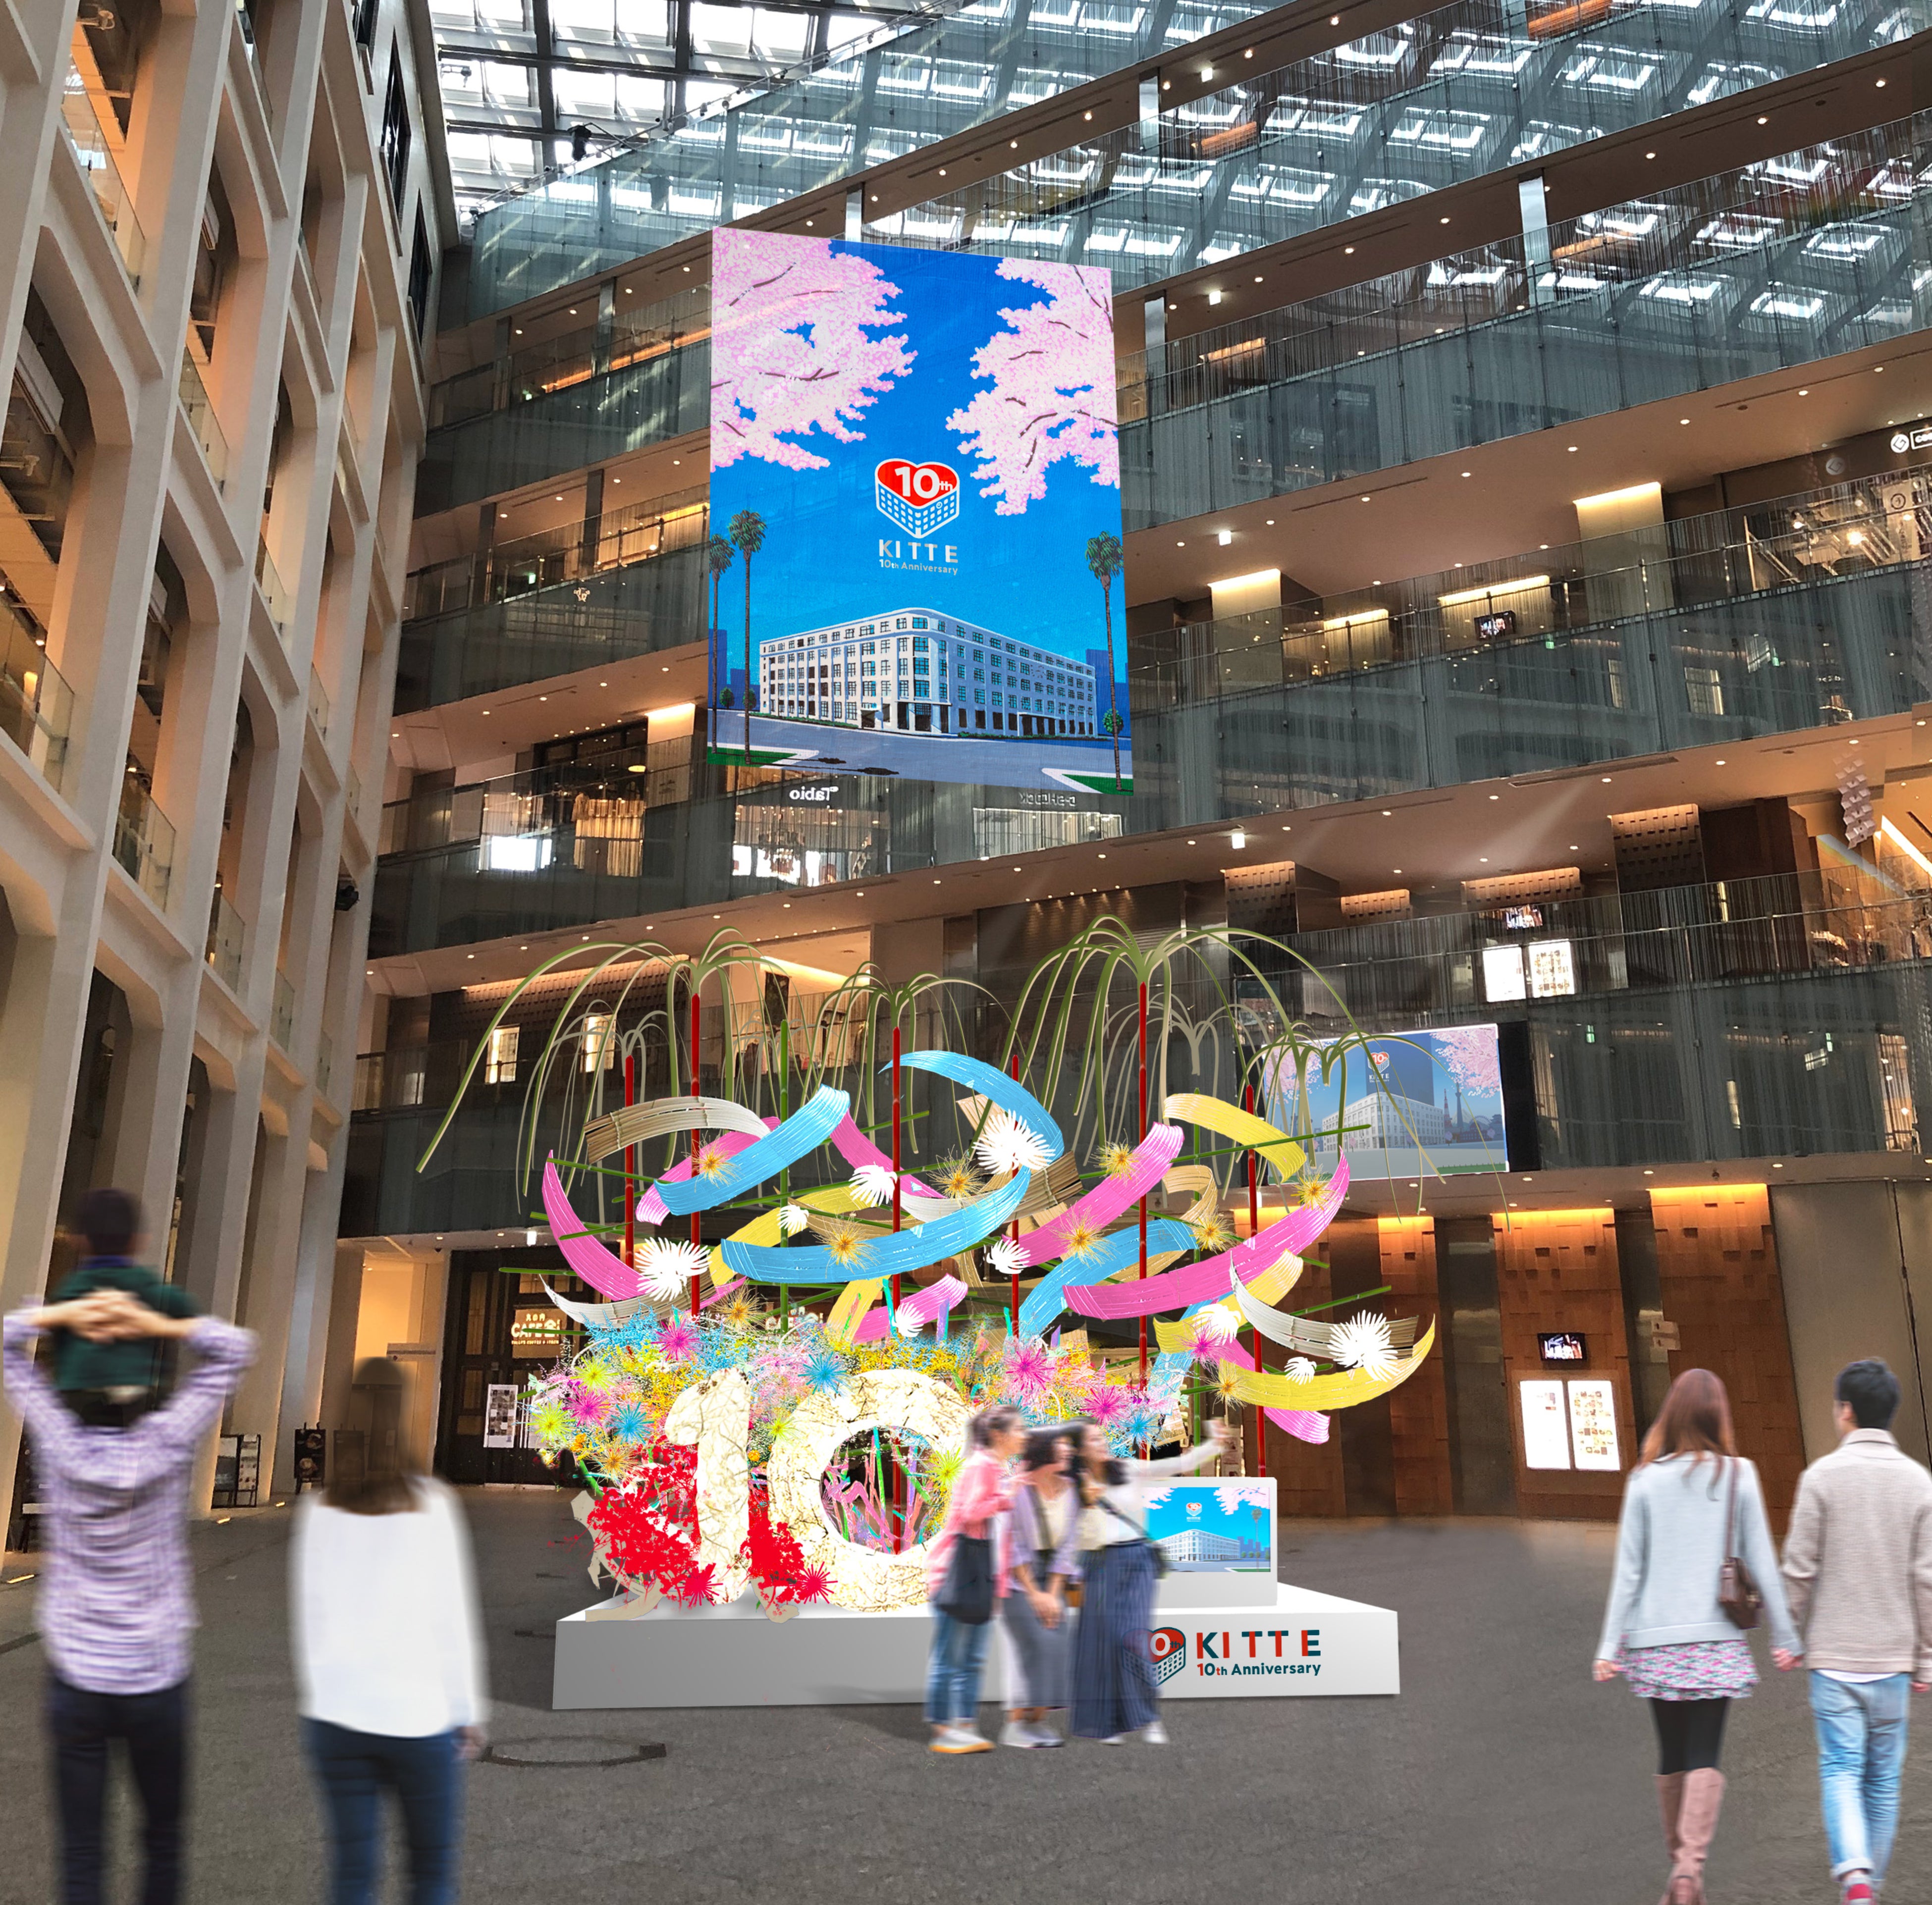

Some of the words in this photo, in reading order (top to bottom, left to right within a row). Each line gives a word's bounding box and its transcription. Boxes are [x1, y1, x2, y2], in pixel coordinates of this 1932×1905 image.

[895, 466, 953, 499] 10th
[879, 539, 958, 563] KITTE
[879, 559, 899, 569] 10th
[901, 562, 958, 575] Anniversary
[664, 1368, 977, 1613] 10
[1196, 1630, 1321, 1659] KITTE
[1197, 1663, 1228, 1676] 10th
[1231, 1662, 1321, 1676] Anniversary
